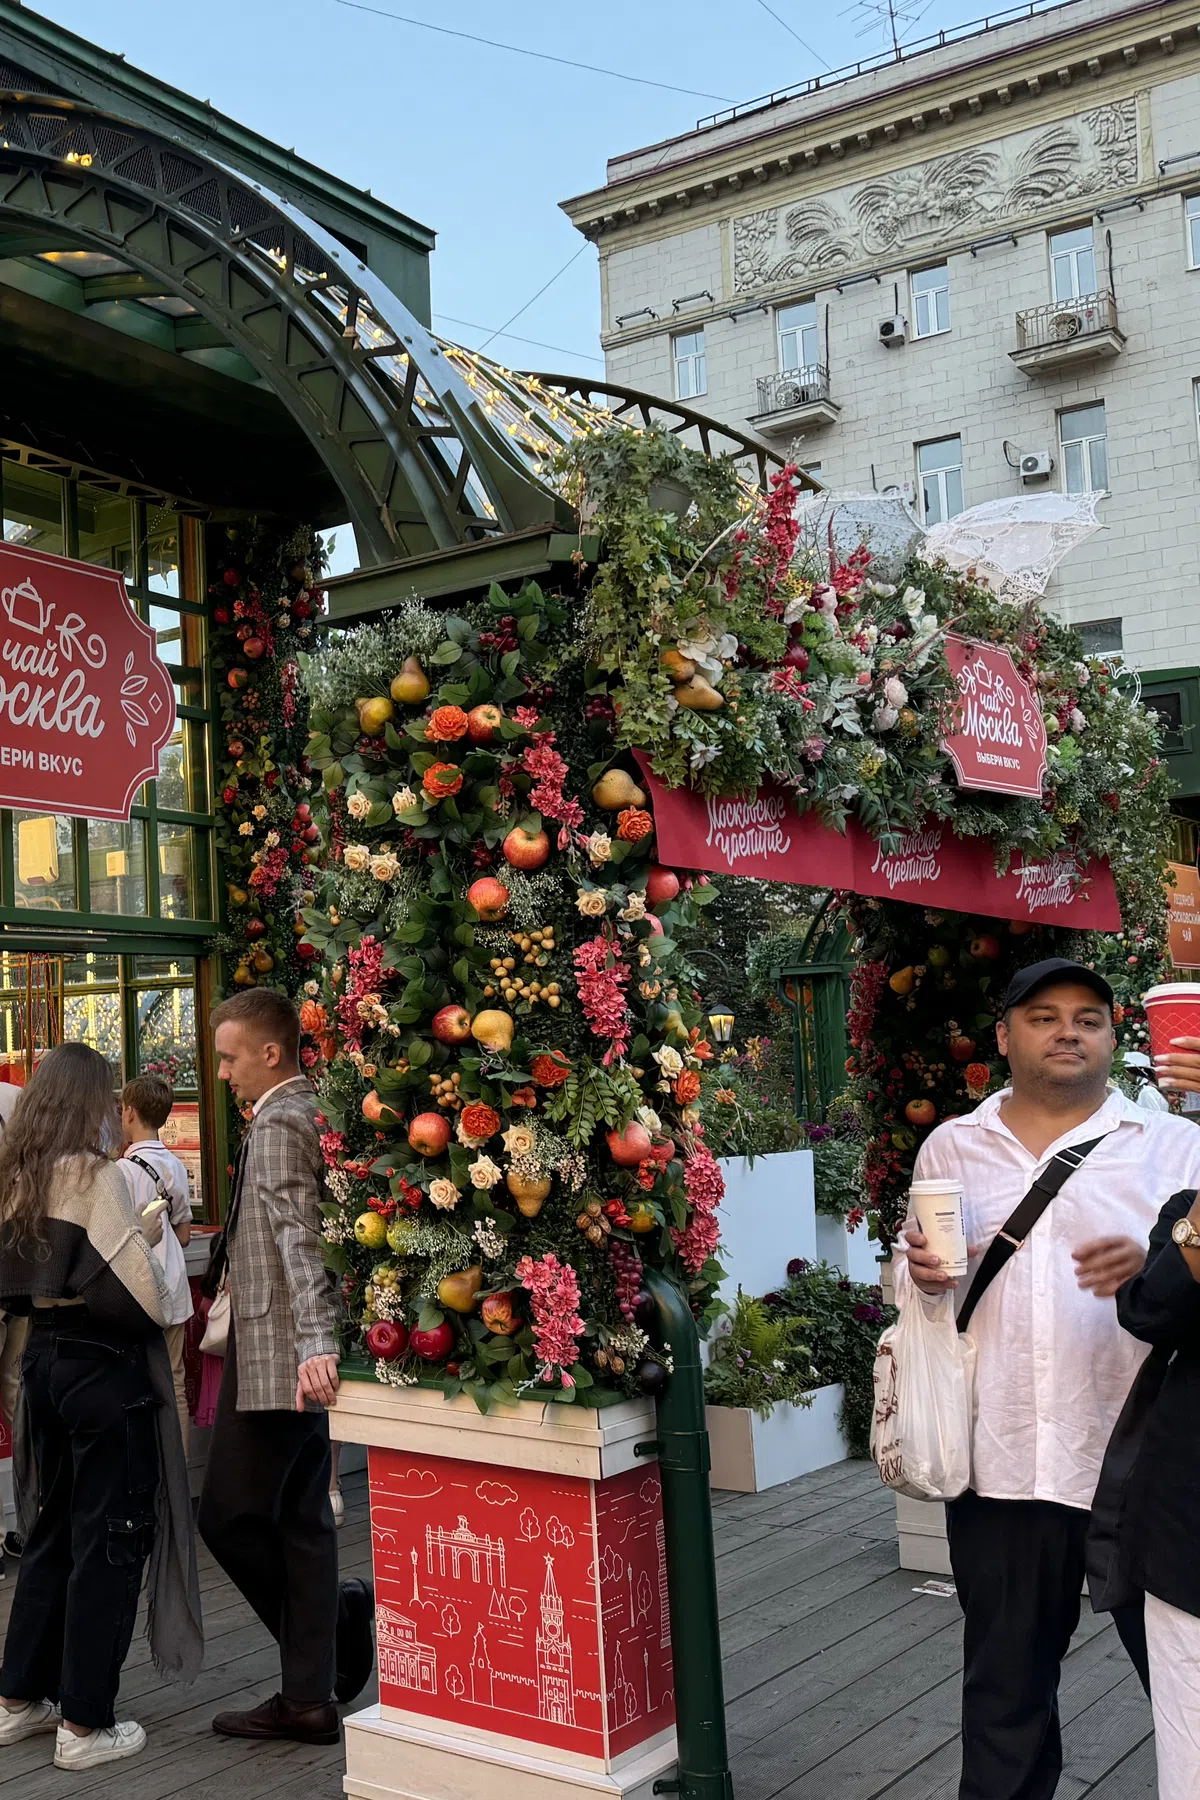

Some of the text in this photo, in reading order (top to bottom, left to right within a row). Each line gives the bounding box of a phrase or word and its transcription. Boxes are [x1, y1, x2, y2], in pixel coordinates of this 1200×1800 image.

[2, 638, 59, 678] чай
[980, 691, 1001, 713] чай
[961, 697, 1023, 748] Москва
[38, 754, 84, 776] ВКУС
[976, 751, 1021, 771] ВЫБЕРИ ВКУС
